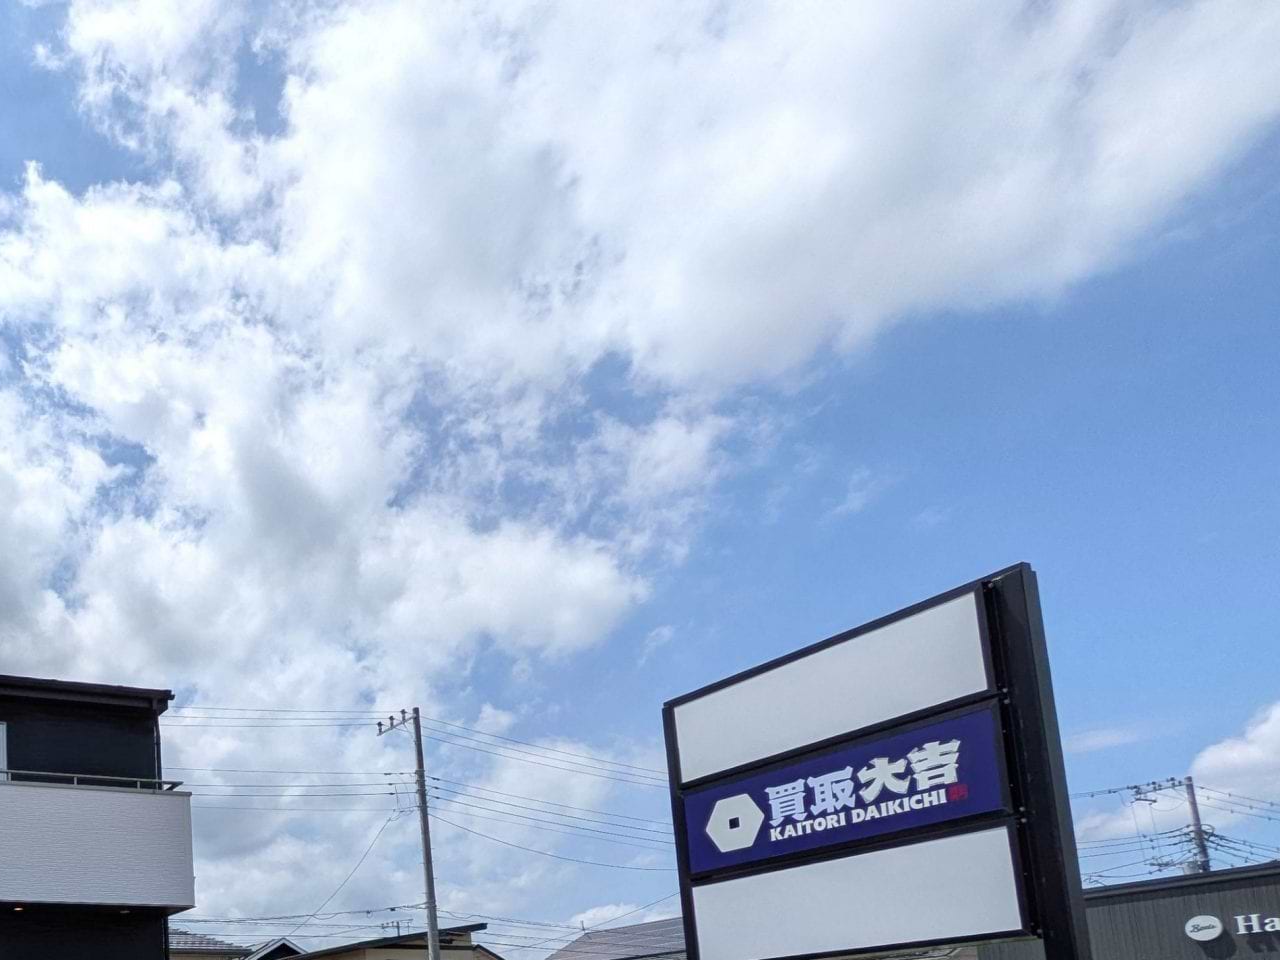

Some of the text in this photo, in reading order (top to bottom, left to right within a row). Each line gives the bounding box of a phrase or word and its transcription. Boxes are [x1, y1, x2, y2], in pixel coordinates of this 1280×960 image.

[764, 739, 961, 827] 買取大吉
[770, 812, 847, 841] KAITORI
[851, 788, 948, 823] DAIKICHI
